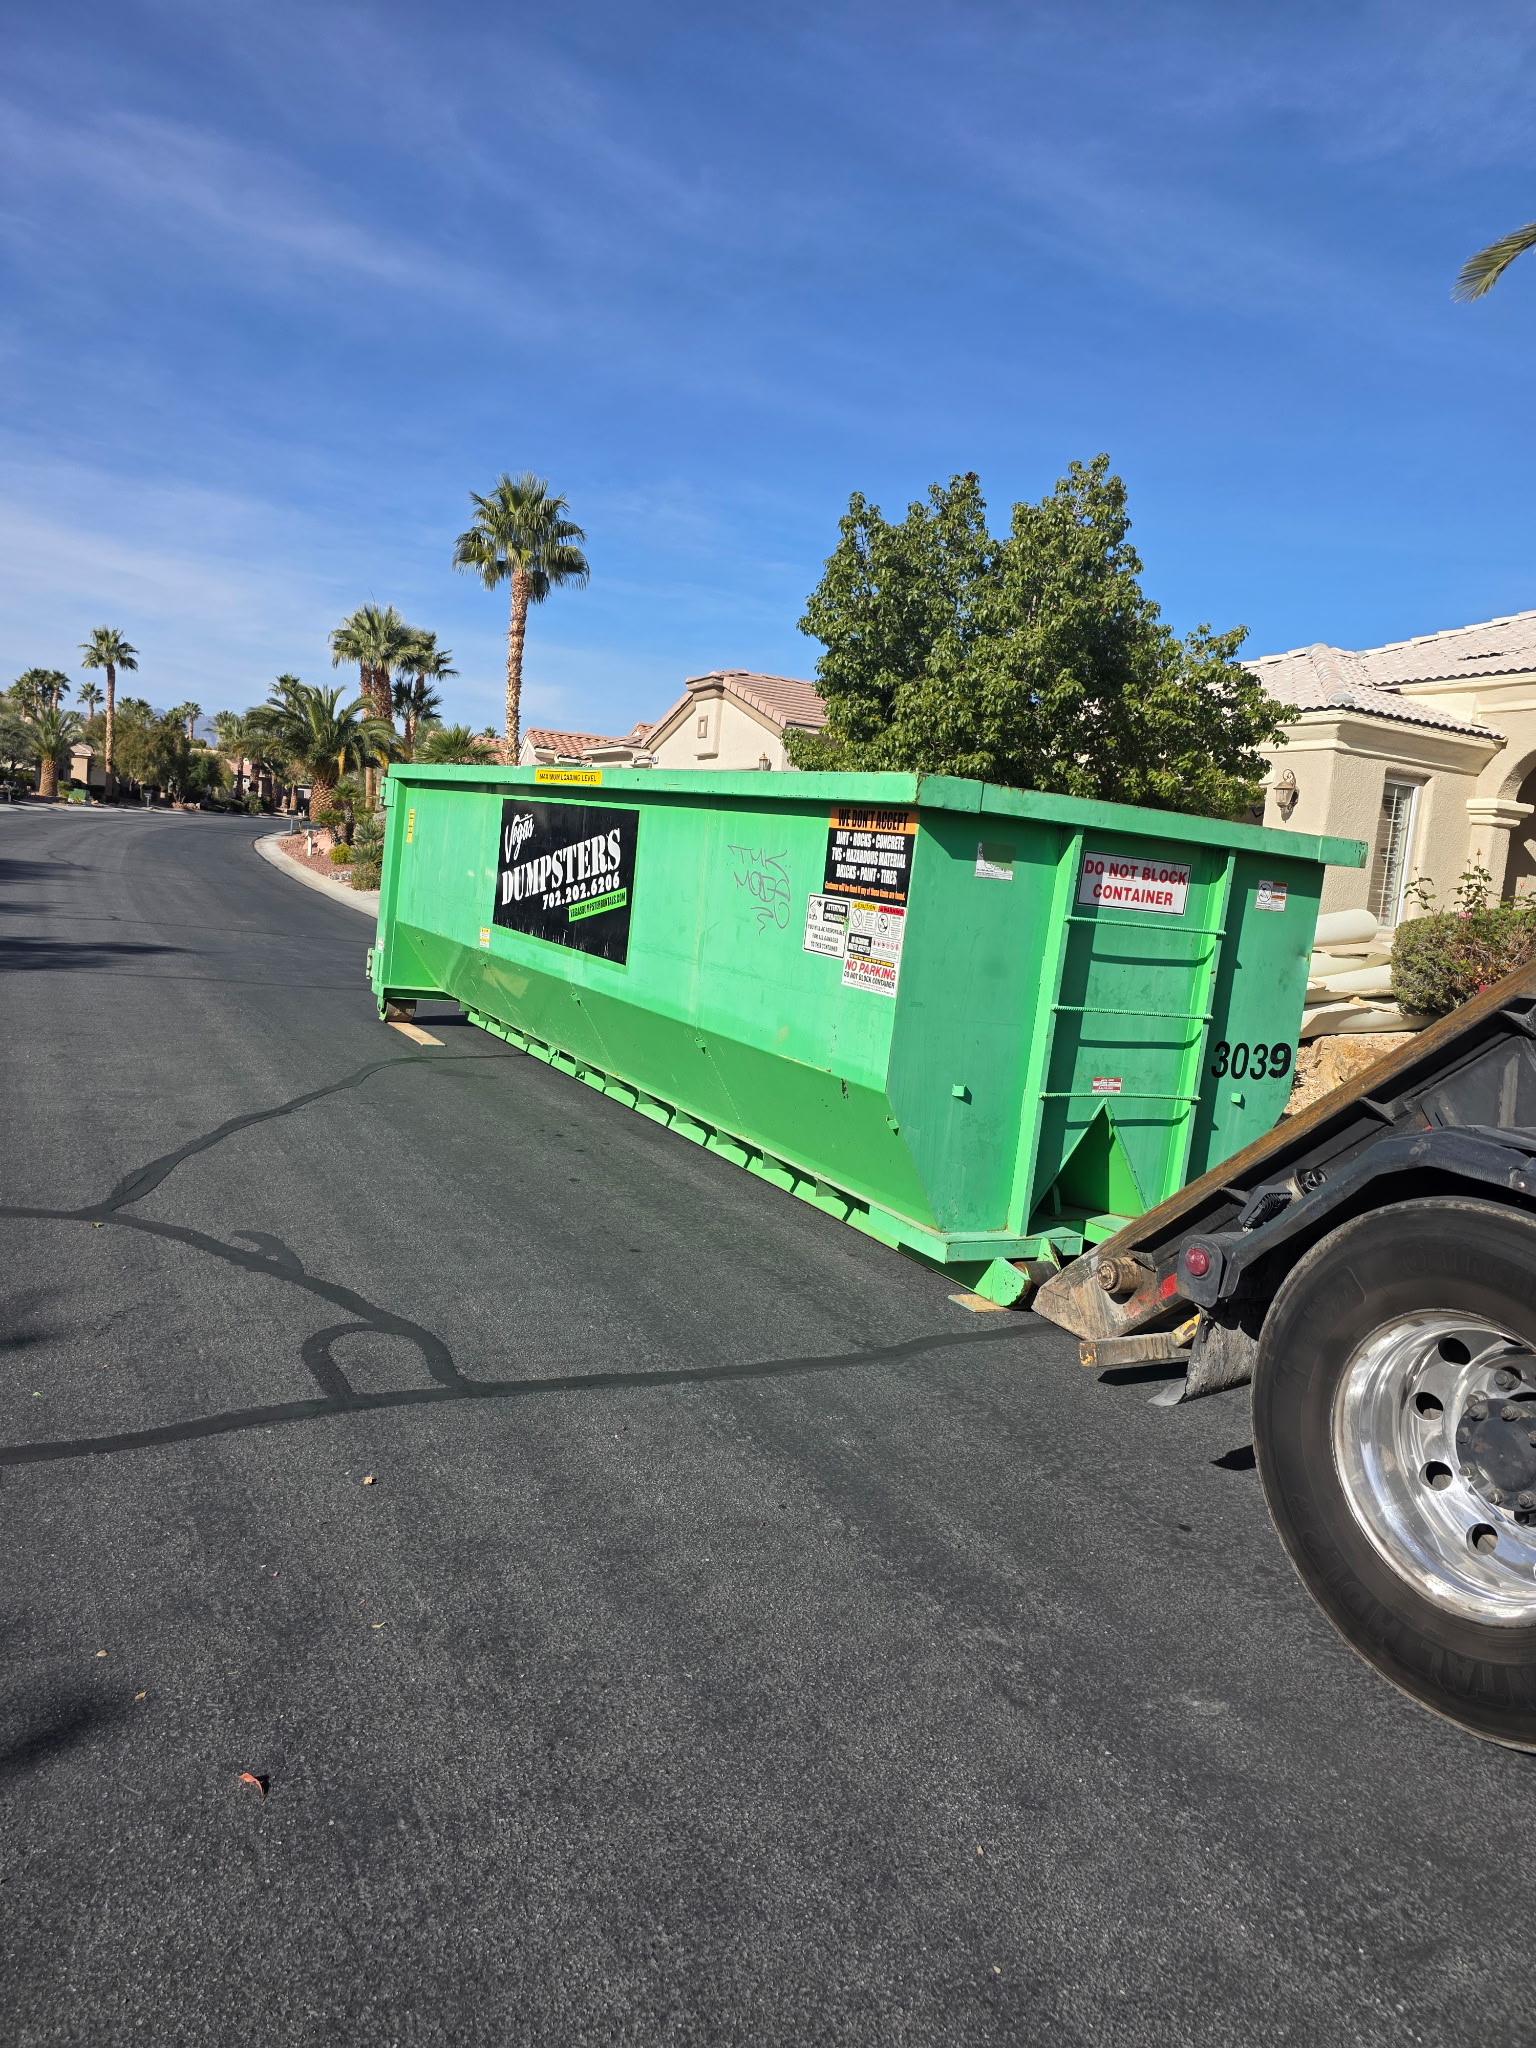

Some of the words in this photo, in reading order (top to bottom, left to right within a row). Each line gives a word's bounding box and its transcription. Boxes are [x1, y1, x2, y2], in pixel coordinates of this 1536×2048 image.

[838, 809, 850, 827] WE
[852, 810, 876, 828] DON'T
[876, 811, 909, 831] ACCEPT
[504, 814, 534, 863] Vegas
[836, 831, 850, 846] DIRT
[852, 832, 872, 848] ROCKS
[876, 834, 905, 850] CONCRETE
[502, 828, 621, 905] DUMPSTERS
[846, 848, 878, 866] HAZARDOUS
[878, 852, 906, 868] MATERIAL
[836, 864, 856, 880] BRICKS
[860, 866, 878, 882] PAINT
[880, 869, 897, 886] TIRES
[1084, 860, 1104, 874] DO
[1108, 863, 1138, 880] NOT
[1142, 866, 1188, 886] BLOCK
[542, 872, 620, 910] 702.202.6206
[1093, 884, 1173, 906] CONTAINER
[845, 960, 857, 971] NO
[859, 962, 896, 981] PARKING
[859, 974, 871, 983] BLOCK
[872, 978, 894, 989] CONTAINER
[1211, 1041, 1292, 1080] 3039
